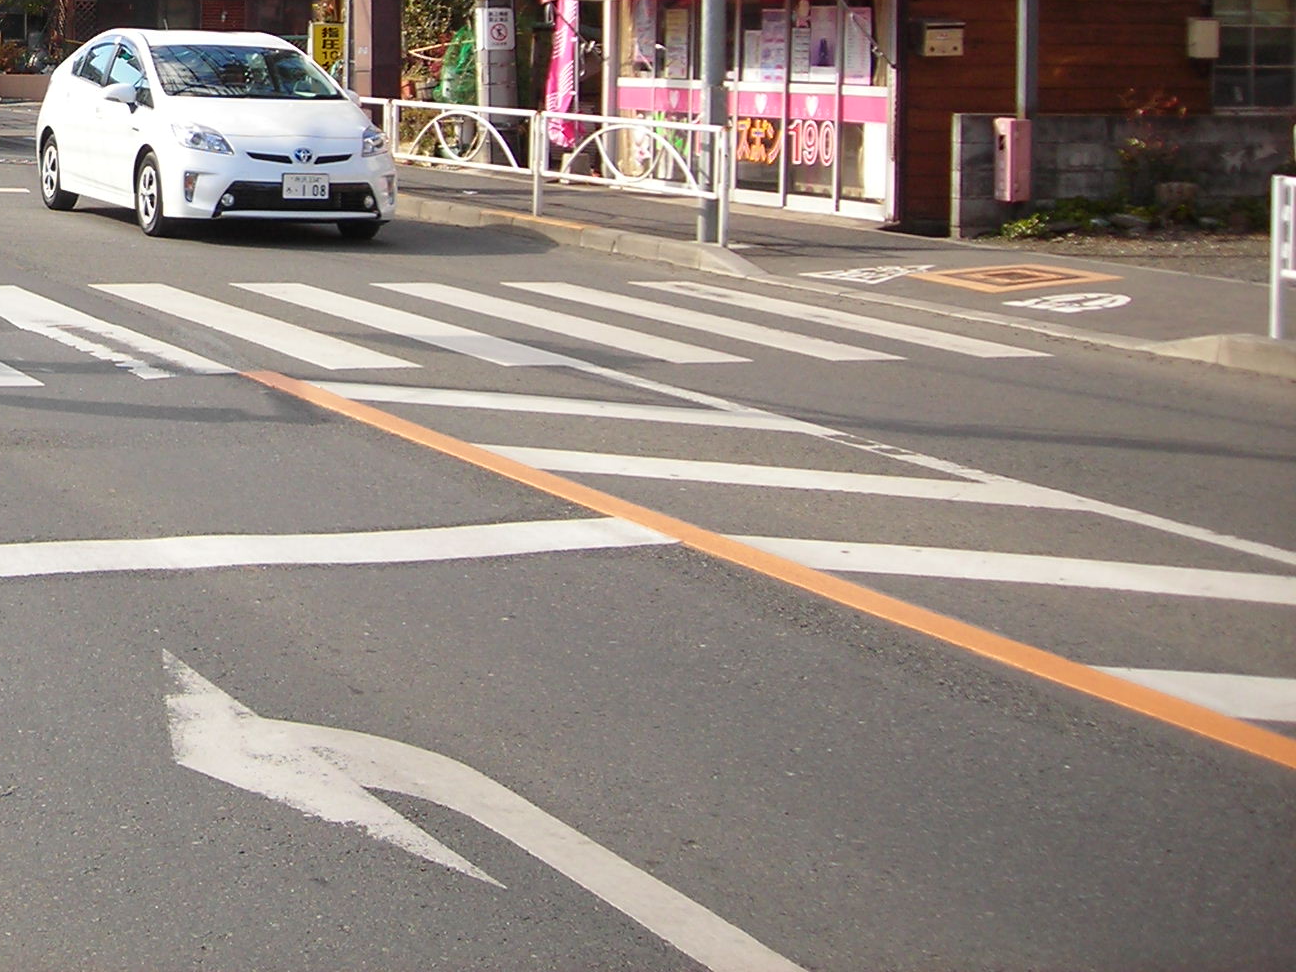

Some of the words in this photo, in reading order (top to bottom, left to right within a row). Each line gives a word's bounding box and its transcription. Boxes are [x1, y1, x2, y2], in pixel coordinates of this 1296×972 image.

[737, 118, 783, 165] ズボン
[788, 119, 836, 167] 190
